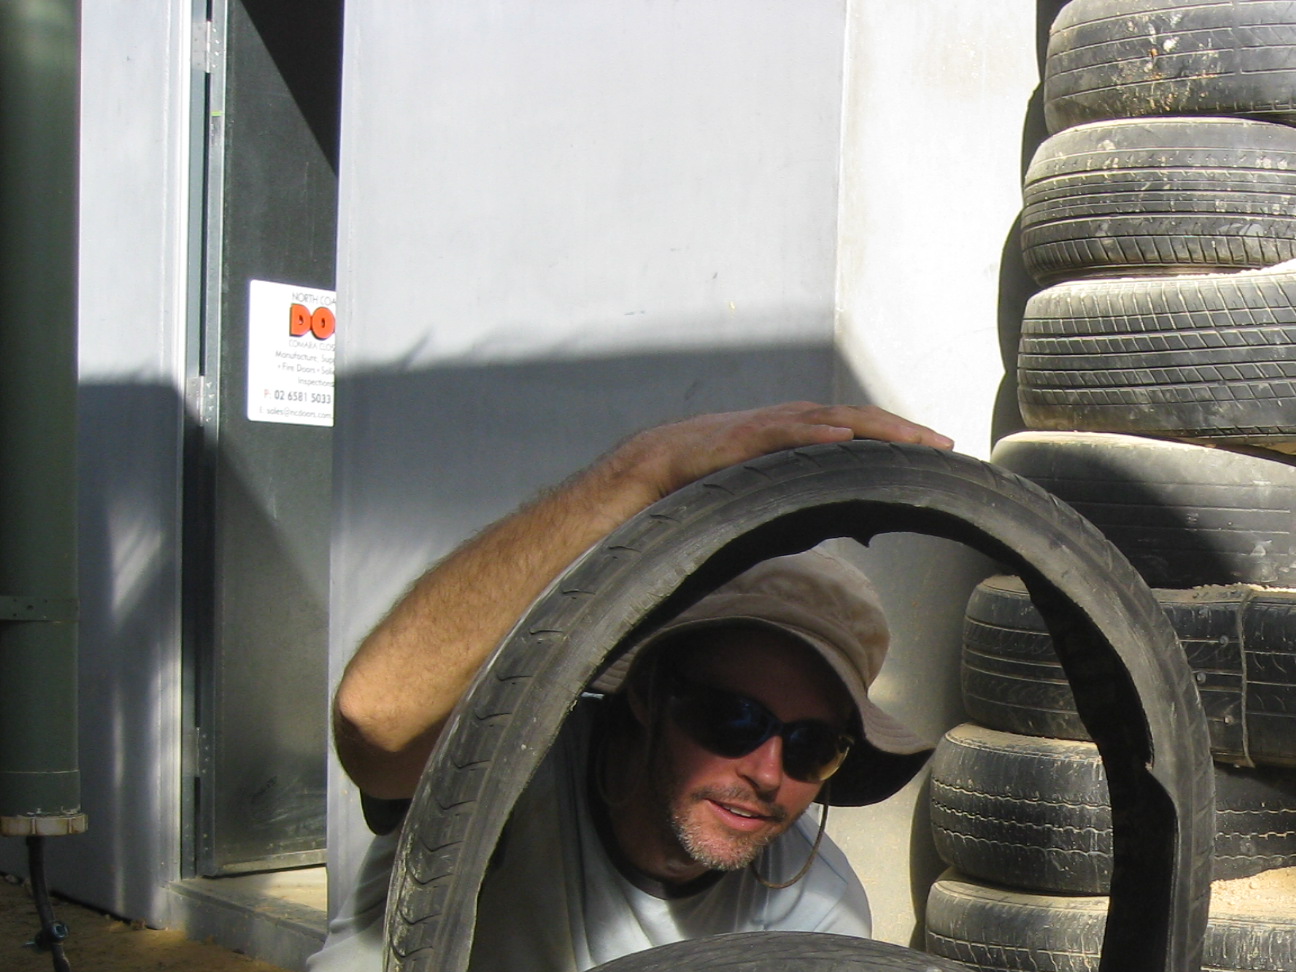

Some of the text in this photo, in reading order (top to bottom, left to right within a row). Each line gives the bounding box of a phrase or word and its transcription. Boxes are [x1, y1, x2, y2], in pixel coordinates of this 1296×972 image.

[292, 293, 318, 304] NORTH
[289, 303, 335, 341] DO
[297, 363, 316, 374] Doors
[274, 389, 285, 401] 02
[288, 391, 307, 402] 6581
[311, 392, 331, 404] 5033
